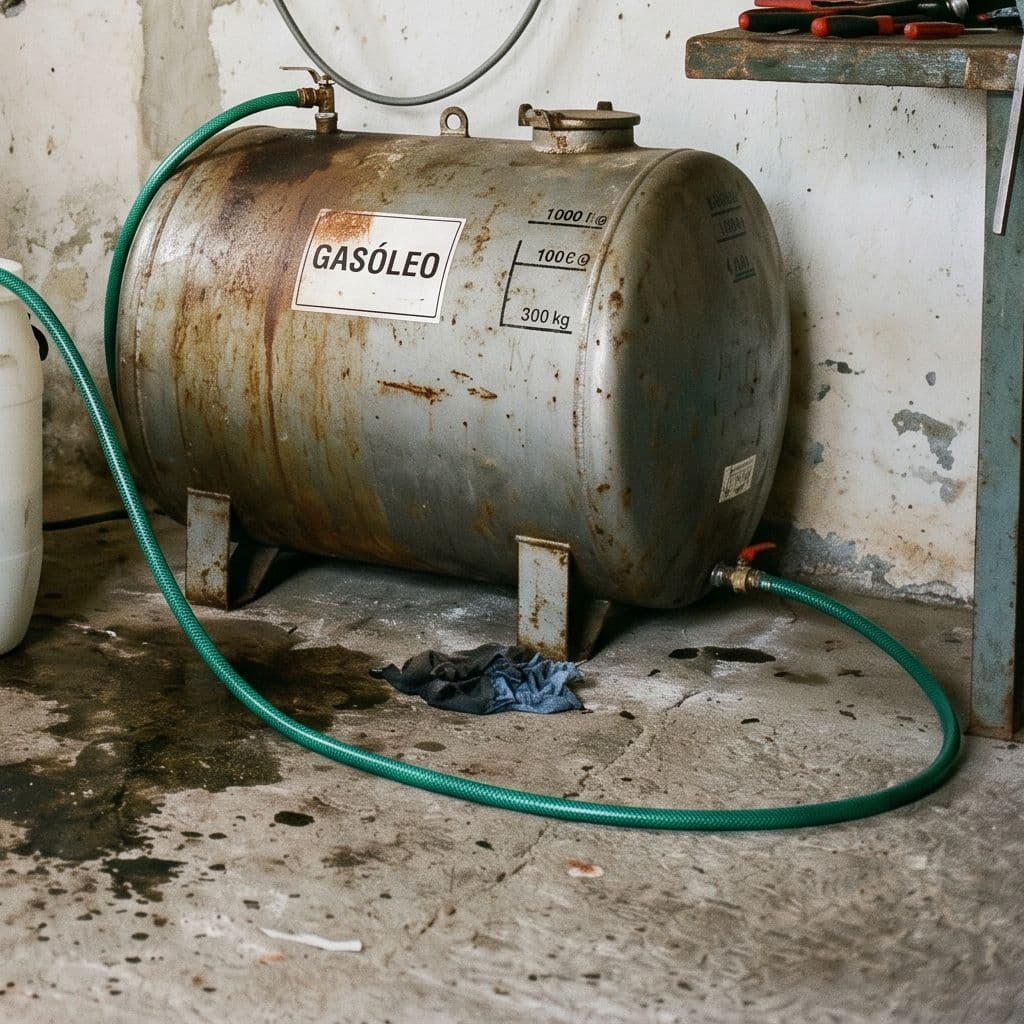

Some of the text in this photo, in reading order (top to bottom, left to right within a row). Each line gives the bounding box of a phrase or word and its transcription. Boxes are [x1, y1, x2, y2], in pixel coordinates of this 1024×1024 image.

[547, 208, 583, 222] 1000
[312, 241, 440, 279] GASÓLEO
[521, 307, 570, 329] 300 kg
